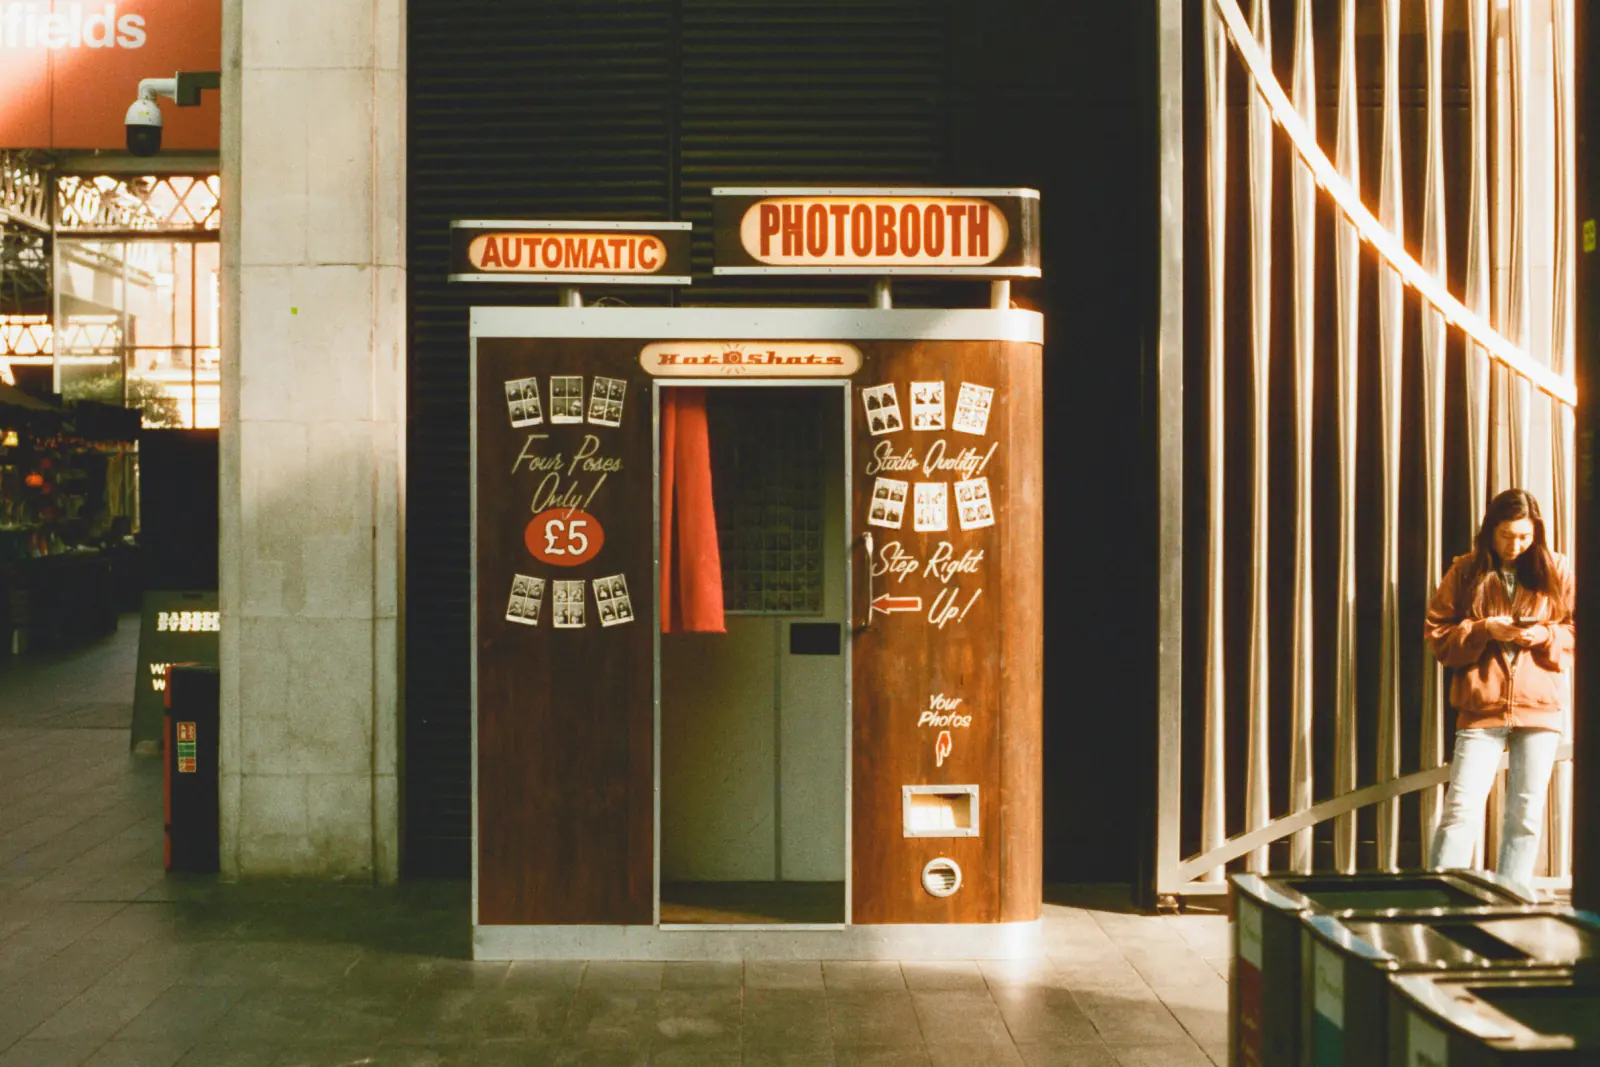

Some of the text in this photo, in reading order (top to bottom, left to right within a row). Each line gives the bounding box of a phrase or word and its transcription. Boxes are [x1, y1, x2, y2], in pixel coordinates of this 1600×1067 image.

[0, 2, 147, 49] fields
[760, 204, 990, 258] PHOTOBOOTH
[481, 236, 658, 269] AUTOMATIC
[511, 434, 621, 476] Four Poses
[866, 440, 999, 480] Studio Quality!
[531, 471, 607, 519] Only!
[544, 519, 588, 555] £5
[872, 541, 984, 584] Step Right
[928, 588, 982, 629] Up!
[917, 711, 972, 727] Photos
[930, 693, 962, 710] Your
